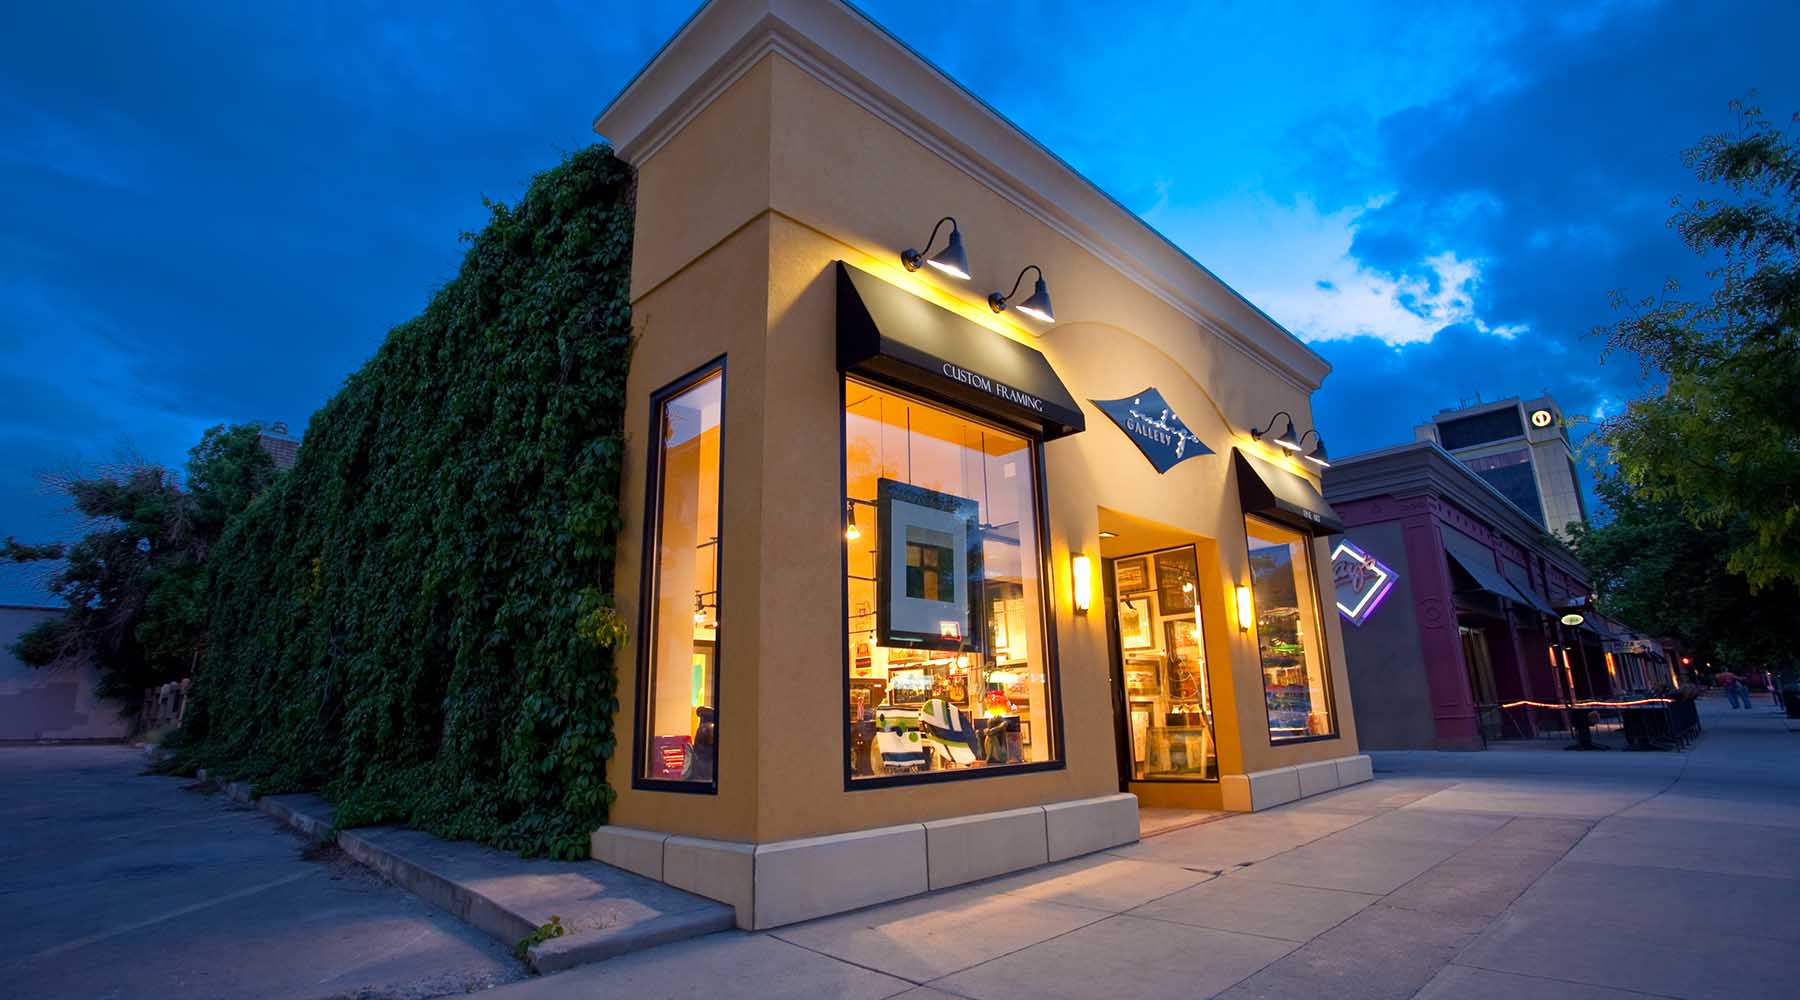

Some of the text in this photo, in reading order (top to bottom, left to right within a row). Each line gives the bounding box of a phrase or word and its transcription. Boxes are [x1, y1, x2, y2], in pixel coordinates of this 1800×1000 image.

[943, 363, 1043, 412] CUSTOM FRAMING
[1126, 418, 1172, 446] GALLERY
